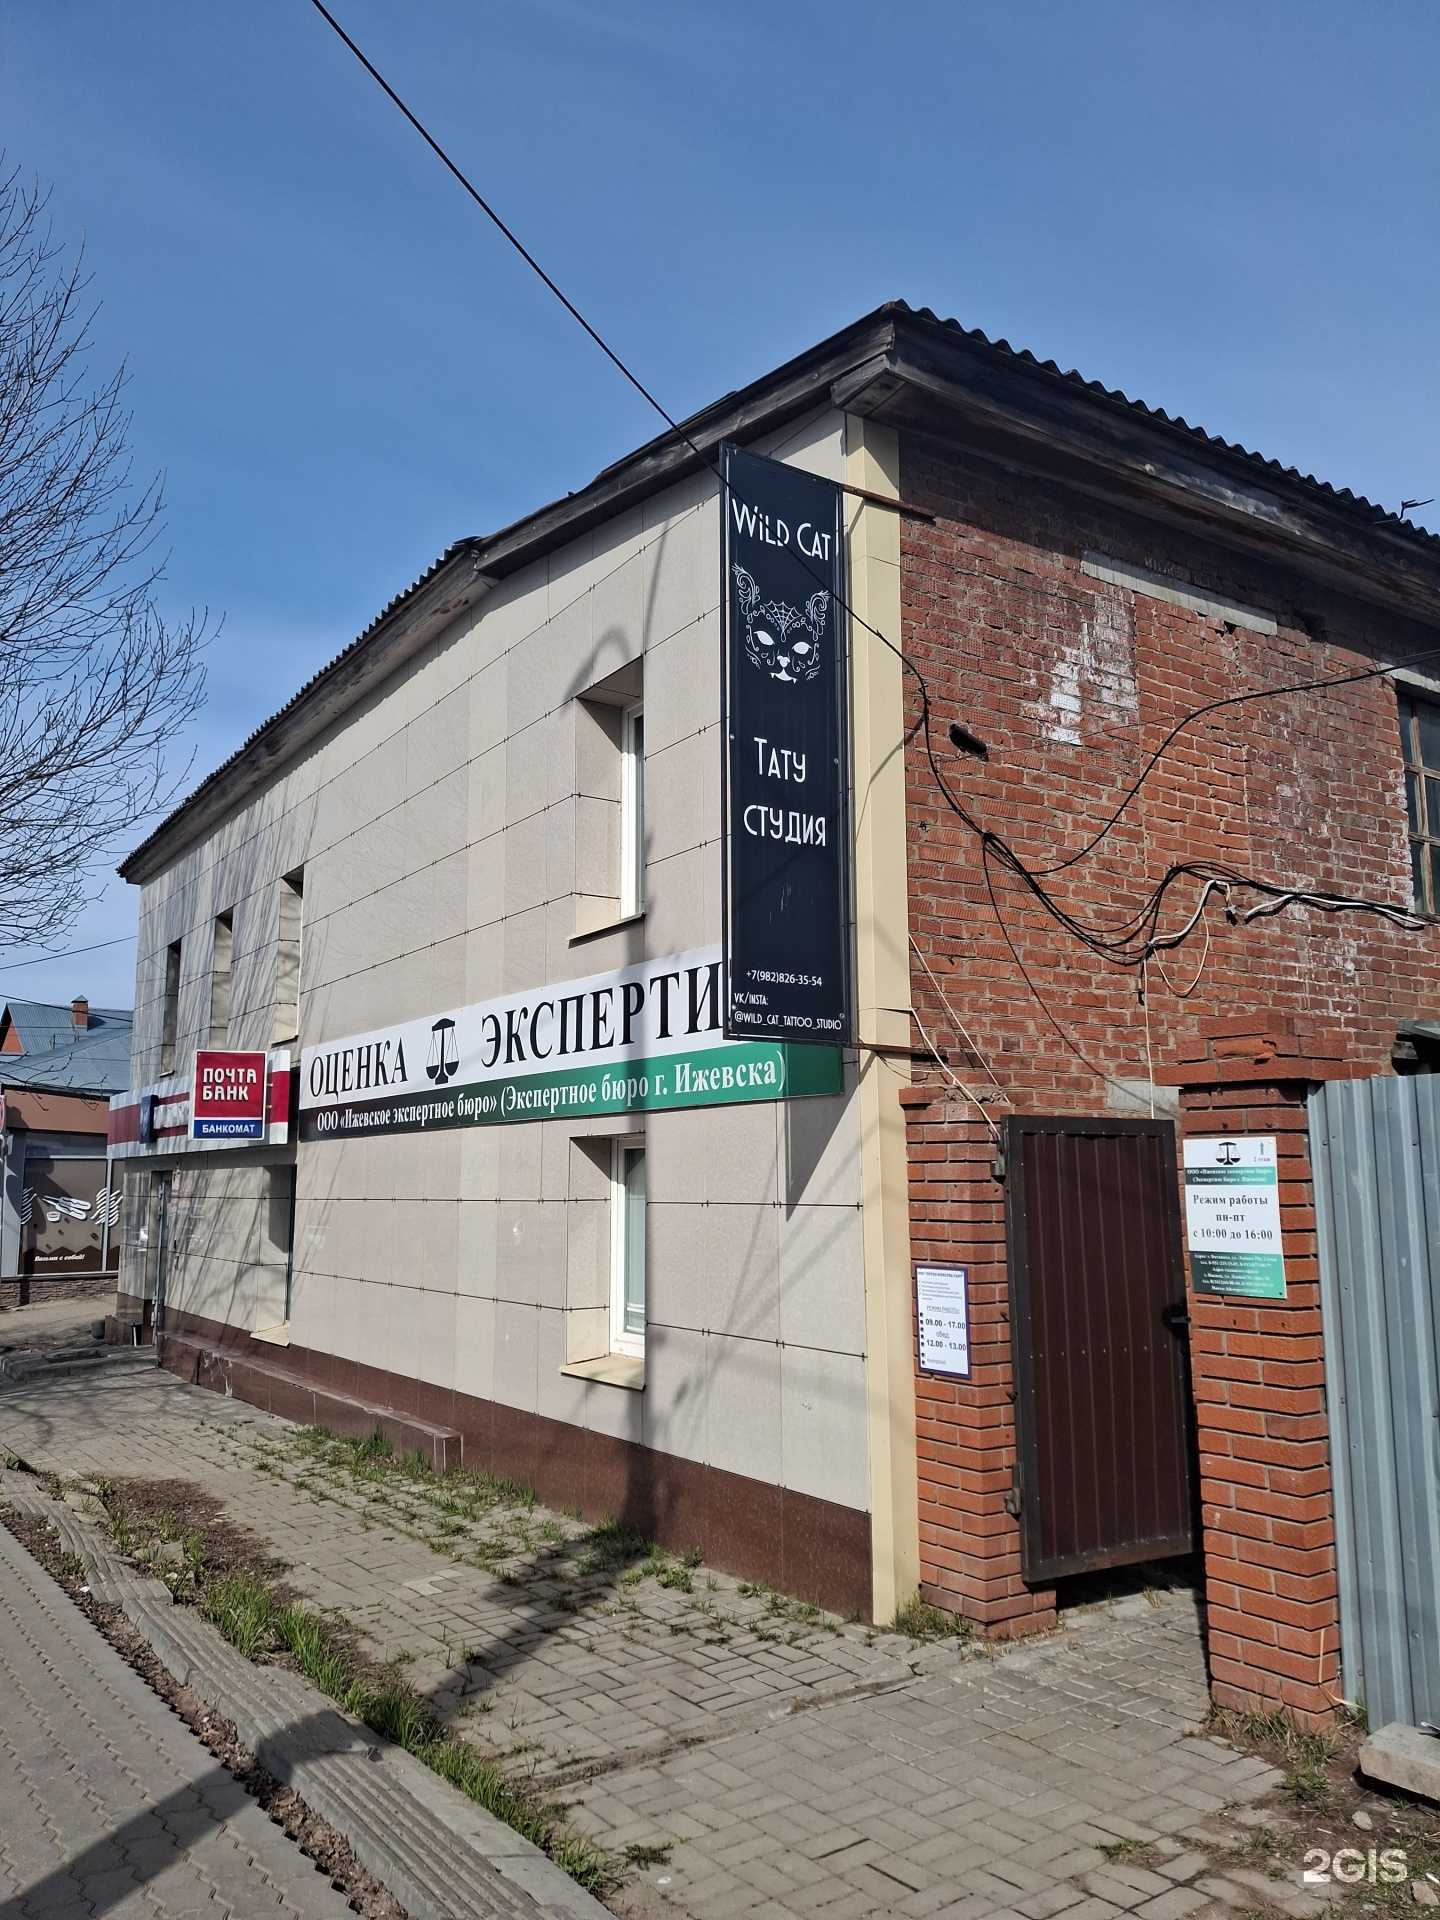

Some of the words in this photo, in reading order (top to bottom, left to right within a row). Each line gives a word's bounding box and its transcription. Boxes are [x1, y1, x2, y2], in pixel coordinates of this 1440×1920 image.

[743, 804, 826, 847] СТУДИЯ
[746, 969, 823, 987] +7(982)826-35-54
[203, 1067, 257, 1084] ПОЧТА
[309, 1036, 409, 1102] ОЦЕНКА
[202, 1085, 249, 1101] БАНК
[317, 1110, 338, 1132] ООО
[392, 1100, 454, 1127] экспертное
[457, 1092, 497, 1121] бюро»
[500, 1083, 597, 1117] (Экспертное
[601, 1073, 649, 1107] бюро
[654, 1073, 668, 1097] г.
[673, 1050, 786, 1095] Ижевска)
[202, 1124, 256, 1134] БАНКОМАТ
[1193, 1194, 1226, 1205] Режим
[1229, 1194, 1268, 1207] работы
[1216, 1213, 1245, 1222] пн-пт
[1193, 1229, 1198, 1238] с
[1201, 1228, 1227, 1239] 10:00
[1230, 1231, 1242, 1240] до
[1245, 1229, 1273, 1241] 16:00
